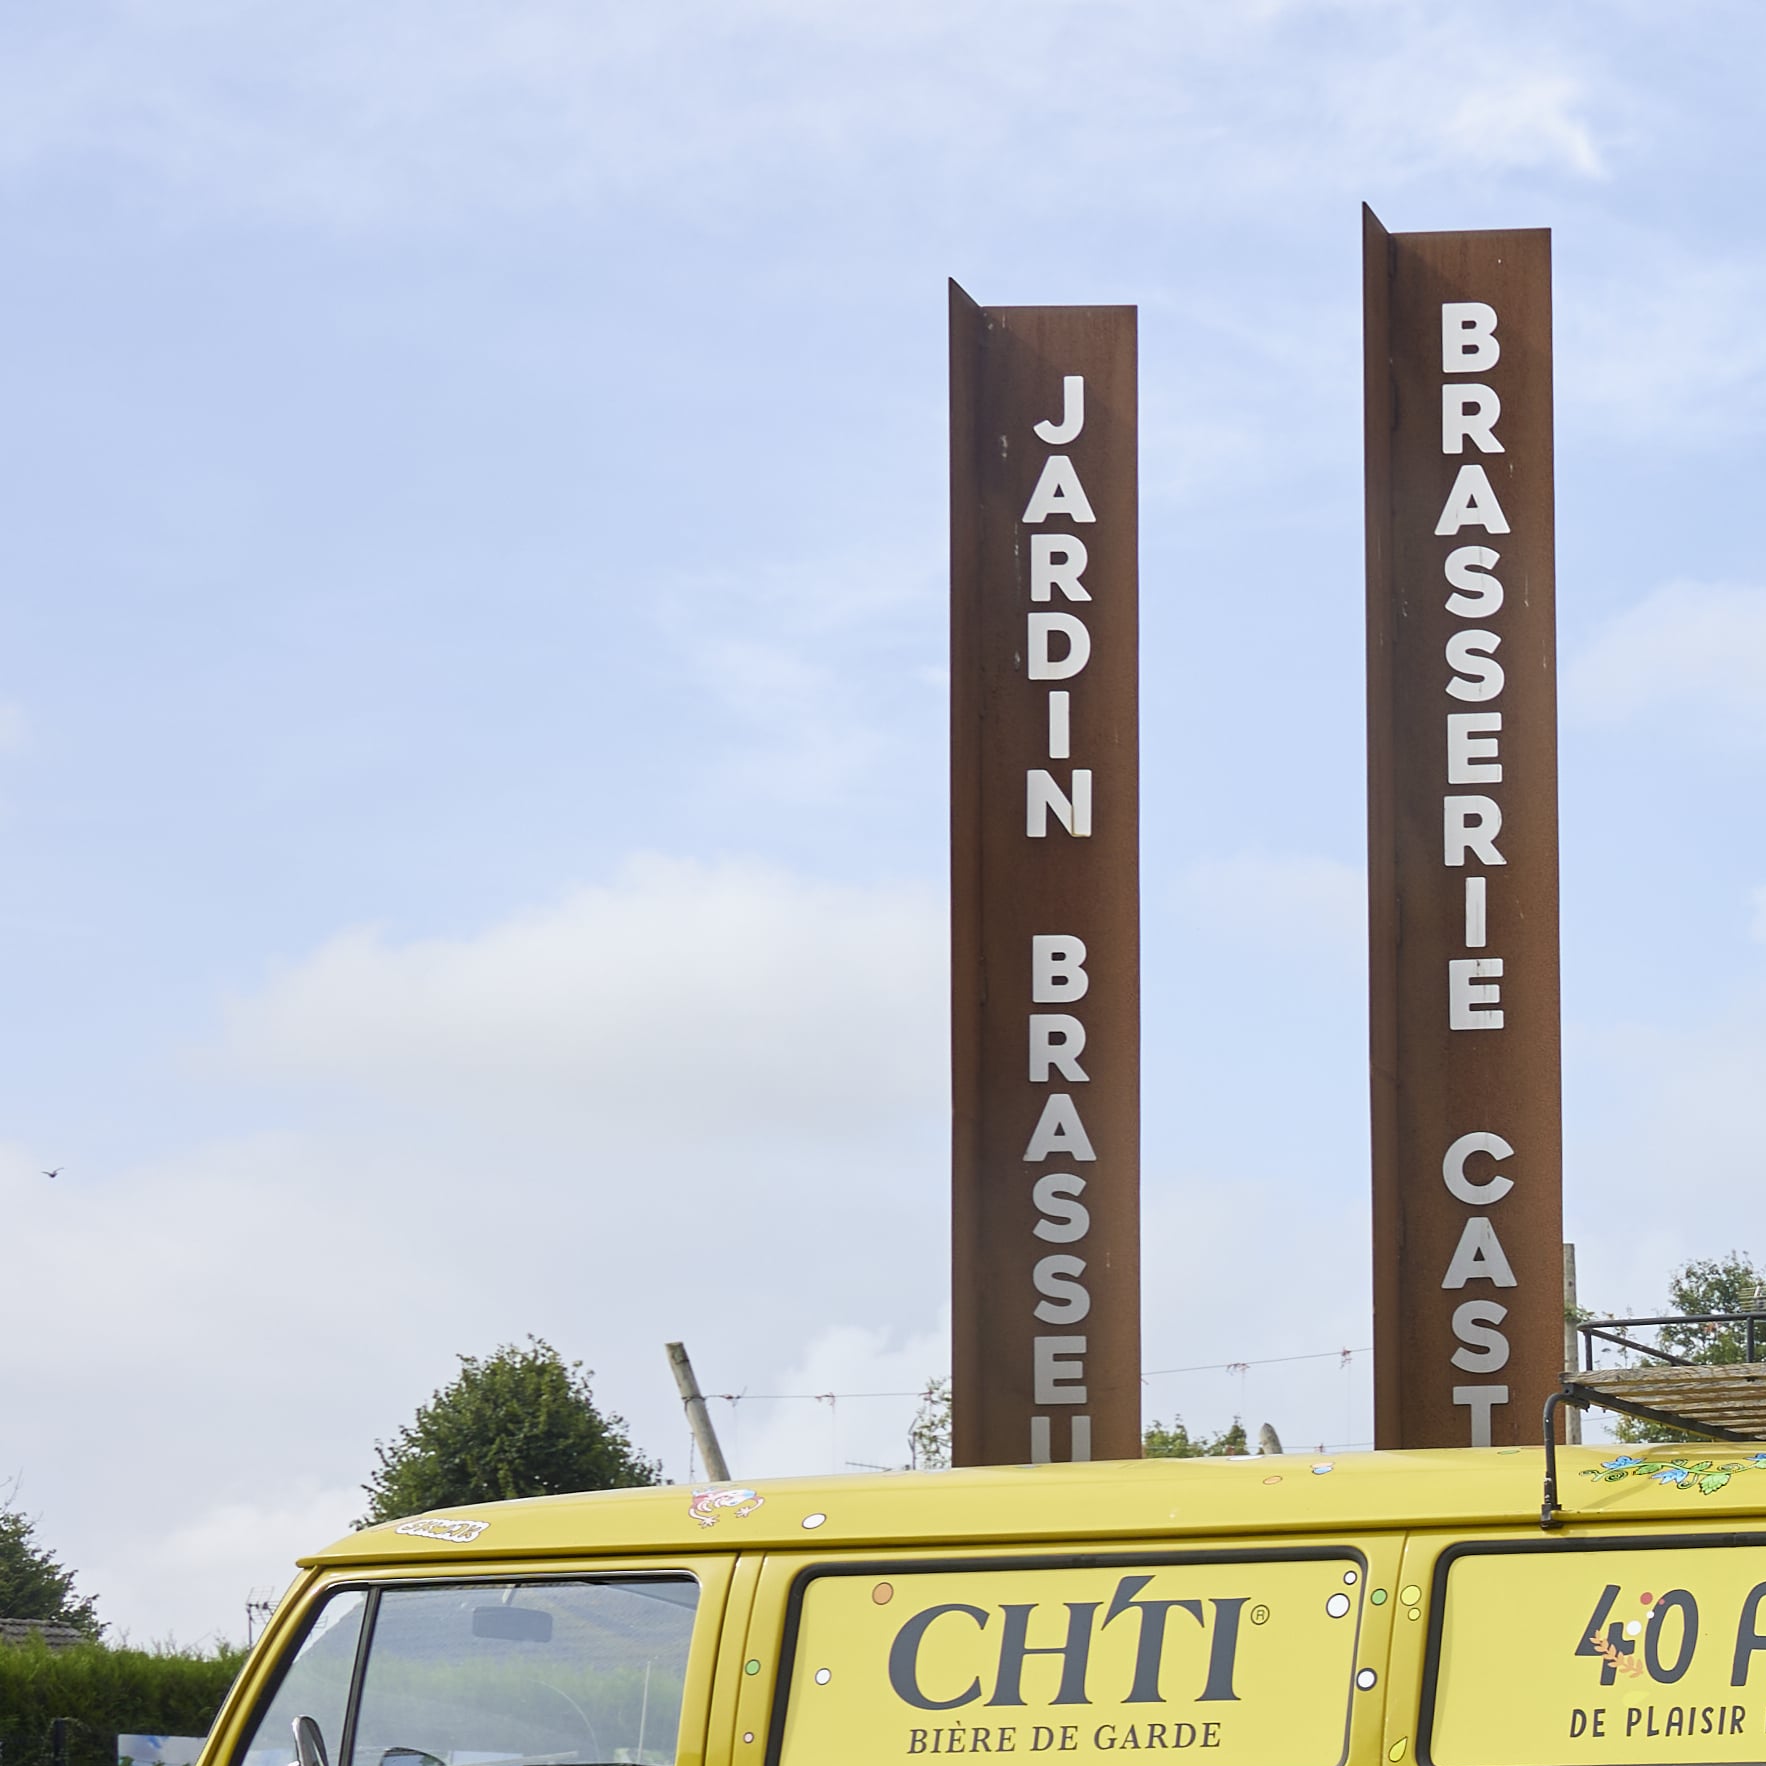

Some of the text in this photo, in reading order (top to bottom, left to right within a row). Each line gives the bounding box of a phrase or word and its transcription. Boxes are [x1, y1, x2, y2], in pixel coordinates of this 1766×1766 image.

[1022, 375, 1097, 838] JARDIN
[1434, 302, 1512, 1031] BRASSERIE
[1574, 1584, 1699, 1686] 40
[906, 1721, 1222, 1755] BIÈRE DE GARDE
[1569, 1707, 1606, 1738] DE
[1626, 1705, 1746, 1737] PLAISIR
